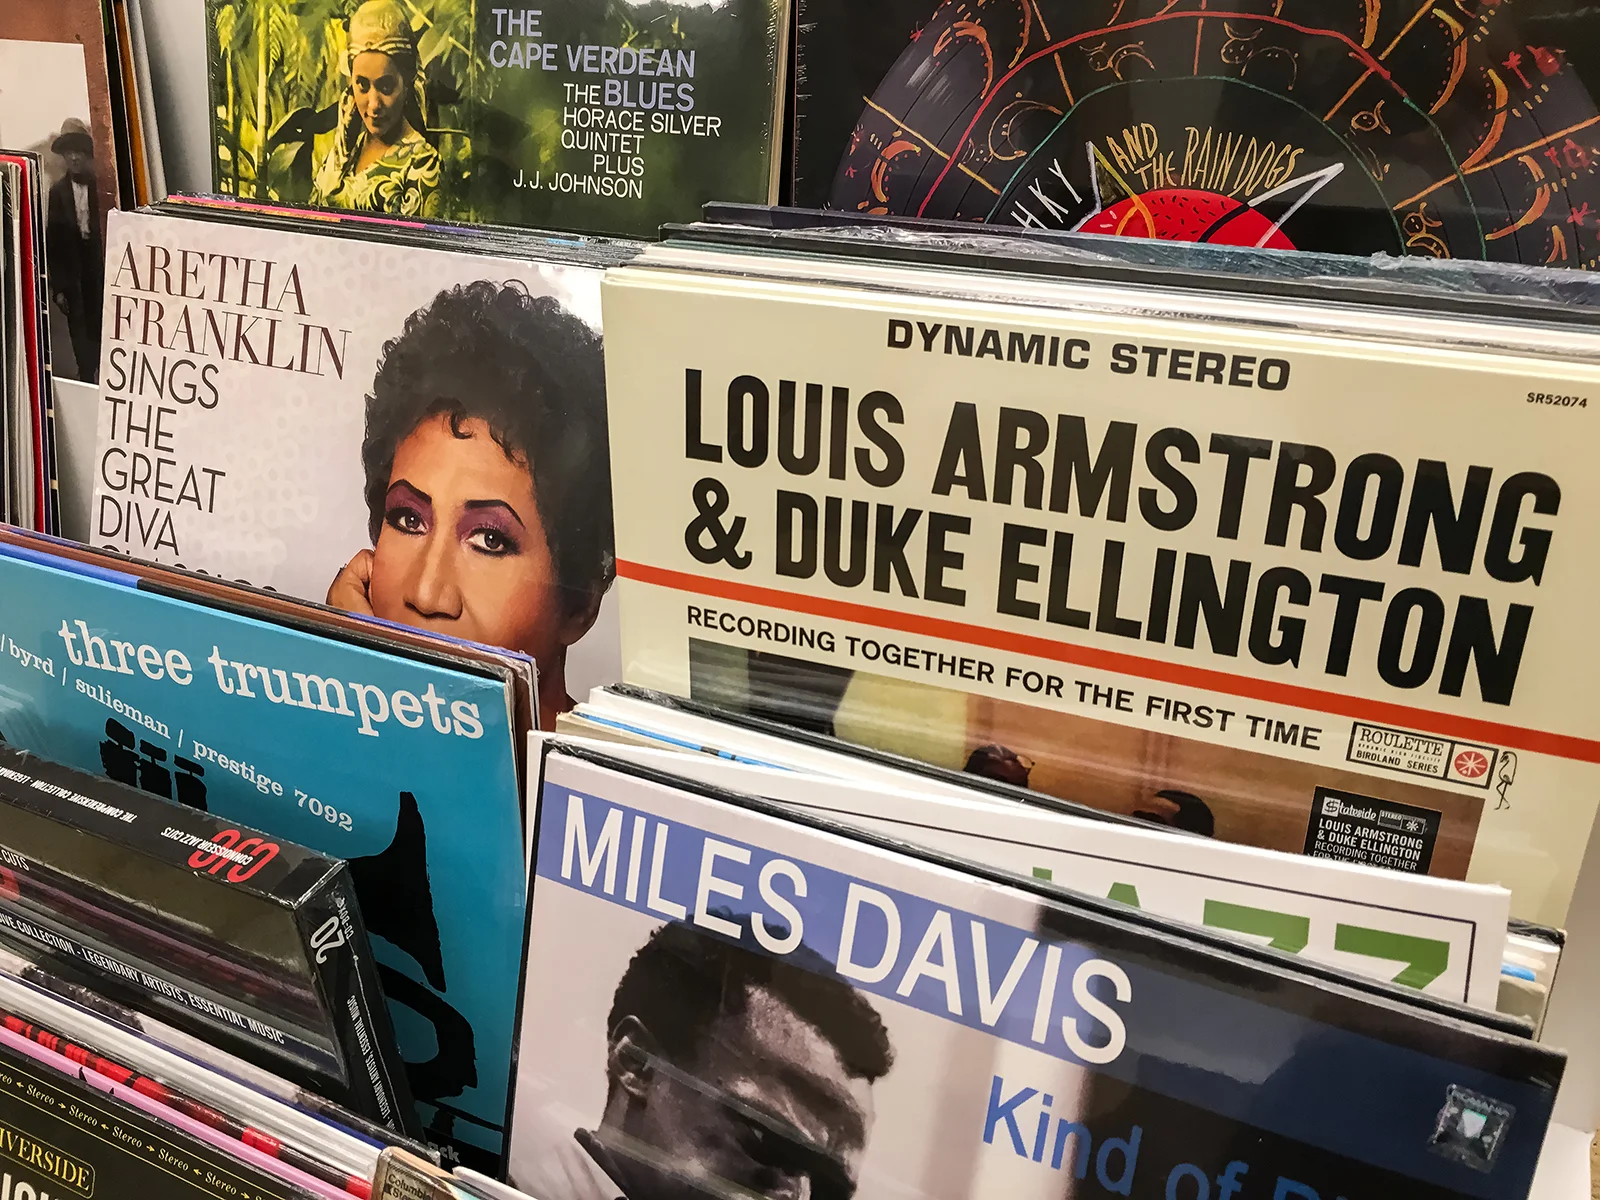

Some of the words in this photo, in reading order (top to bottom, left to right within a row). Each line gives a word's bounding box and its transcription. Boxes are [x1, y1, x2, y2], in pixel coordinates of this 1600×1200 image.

[492, 8, 542, 37] THE
[489, 41, 558, 71] CAPE
[566, 44, 695, 78] VERDEAN
[563, 83, 601, 104] THE
[604, 79, 695, 112] BLUES
[563, 107, 645, 132] HORACE
[651, 112, 722, 137] SILVER
[561, 129, 645, 154] QUINTET
[1106, 123, 1158, 174] AND
[593, 154, 645, 177] PLUS
[1134, 151, 1178, 190] THE
[1181, 126, 1243, 191] RAIN
[1228, 136, 1304, 198] DOGS
[549, 172, 643, 199] JOHNSON
[110, 241, 311, 316] ARETHA
[110, 293, 353, 380] FRANKLIN
[887, 318, 1091, 370] DYNAMIC
[1110, 343, 1291, 392] STEREO
[106, 347, 219, 409] SINGS
[1526, 391, 1588, 408] SR52074
[104, 396, 177, 453] THE
[101, 447, 226, 514] GREAT
[685, 367, 905, 488] LOUIS
[931, 401, 1562, 587] ARMSTRONG
[99, 494, 180, 556] DIVA
[684, 477, 753, 570] &
[776, 489, 972, 607] DUKE
[996, 521, 1534, 707] ELLINGTON
[58, 619, 193, 686] three
[207, 645, 485, 739] trumpets
[687, 605, 836, 653] RECORDING
[845, 635, 994, 684] TOGETHER
[1005, 667, 1064, 699] FOR
[1075, 680, 1134, 713] THE
[1145, 695, 1235, 733] FIRST
[1246, 713, 1324, 751] TIME
[8, 638, 56, 678] byrd
[75, 678, 171, 740] sulieman
[192, 740, 284, 798] prestige
[293, 789, 353, 832] 7092
[1360, 728, 1444, 756] ROULETTE
[1356, 750, 1401, 766] BIRDLAND
[1407, 760, 1439, 774] SERIES
[30, 779, 72, 800] COLLECTION
[120, 811, 137, 824] THE
[160, 826, 184, 841] CUTS
[1319, 818, 1352, 834] LOUIS
[1354, 826, 1423, 849] ARMSTRONG
[1380, 810, 1402, 821] STEREO
[179, 833, 203, 847] JAZZ
[197, 839, 254, 866] CONNOISSEUR
[1314, 840, 1368, 860] RECORDING
[1370, 852, 1418, 871] TOGETHER
[1317, 830, 1325, 840] &
[1328, 832, 1358, 847] DUKE
[1360, 838, 1421, 861] ELLINGTON
[1, 849, 30, 872] CUTS
[310, 915, 346, 965] 20
[560, 794, 808, 956] MILES
[835, 882, 1133, 1065] DAVIS
[16, 919, 75, 956] COLLECTION
[81, 948, 141, 983] LEGENDARY
[142, 974, 189, 1006] ARTISTS,
[189, 995, 247, 1029] ESSENTIAL
[247, 1018, 285, 1045] MUSIC
[346, 994, 361, 1021] MUSIC
[354, 1016, 372, 1056] ESSENTIAL
[26, 1083, 55, 1106] Stereo
[68, 1104, 98, 1127] Stereo
[112, 1125, 143, 1149] Stereo
[158, 1148, 189, 1172] Stereo
[205, 1171, 237, 1196] Stereo
[982, 1074, 1143, 1197] Kind
